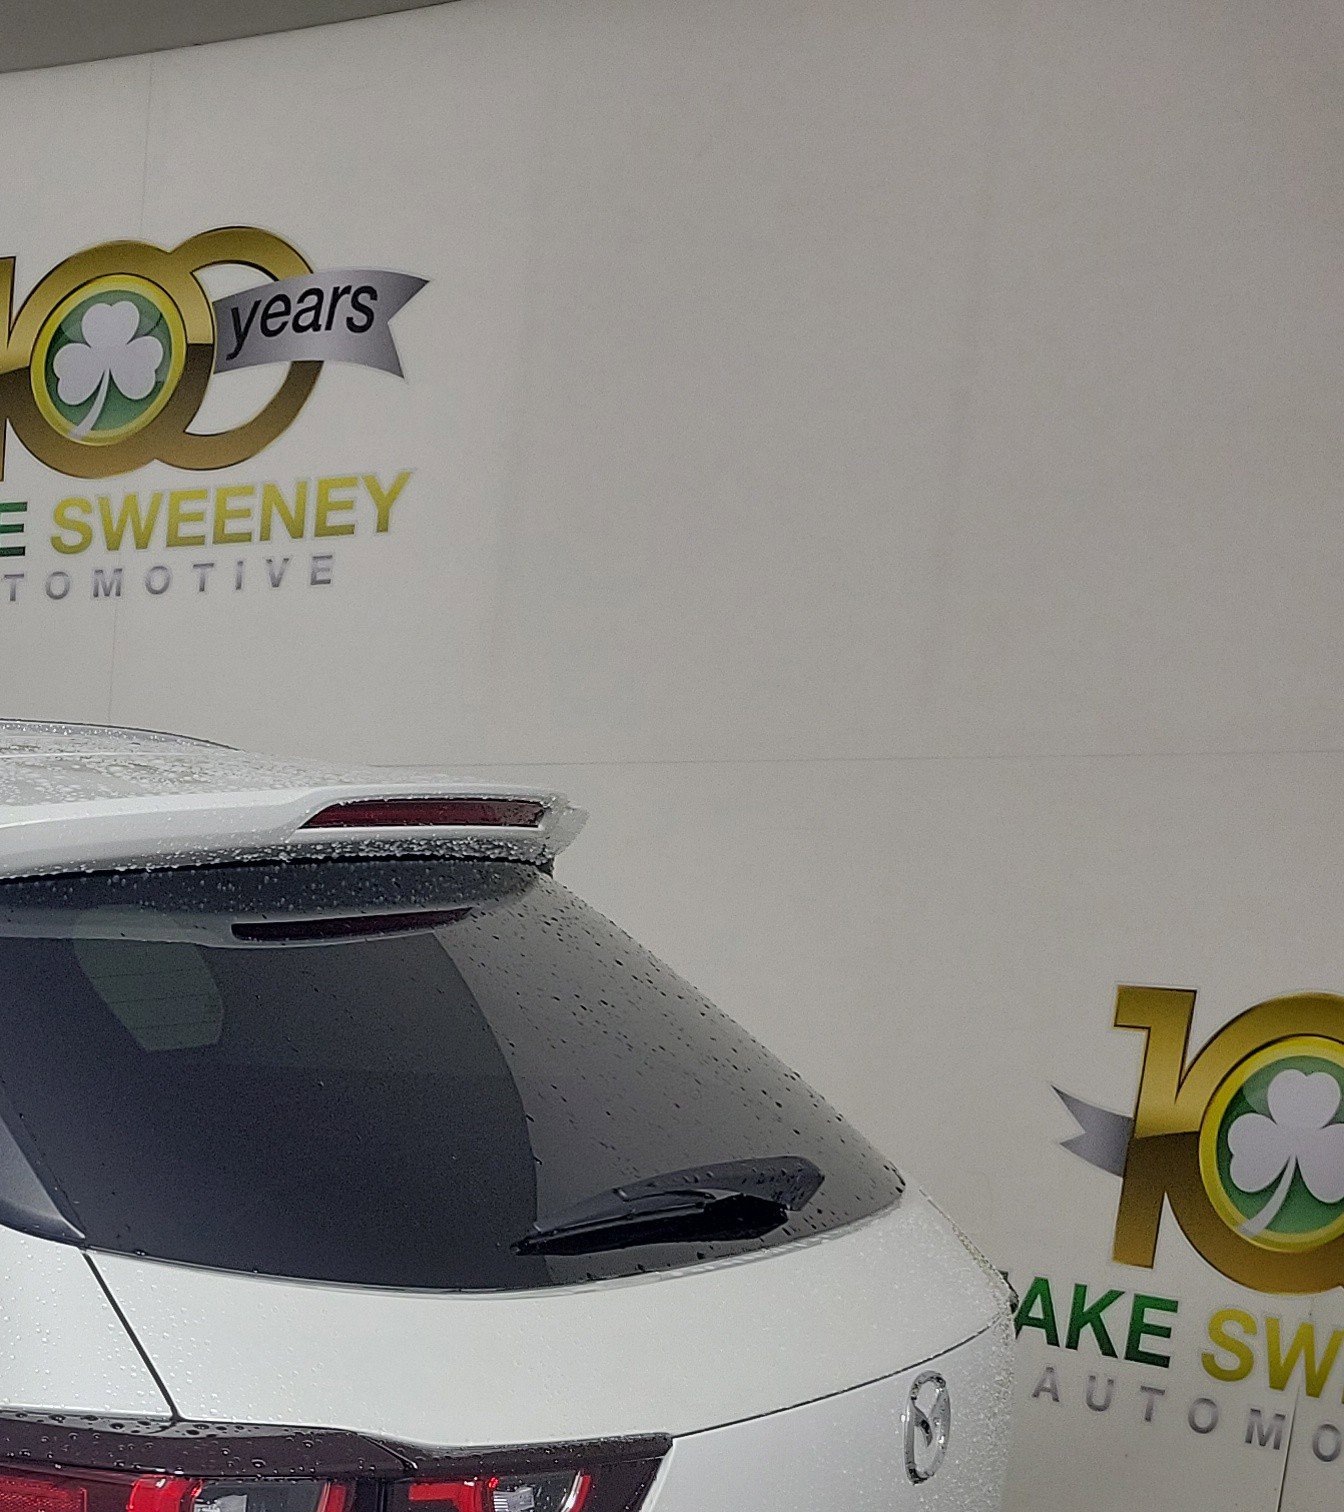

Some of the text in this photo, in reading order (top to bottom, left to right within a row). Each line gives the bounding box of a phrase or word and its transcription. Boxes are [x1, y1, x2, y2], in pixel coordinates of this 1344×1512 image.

[225, 284, 379, 361] years
[50, 470, 413, 556] SWEENEY
[999, 1269, 1344, 1405] AKE SW
